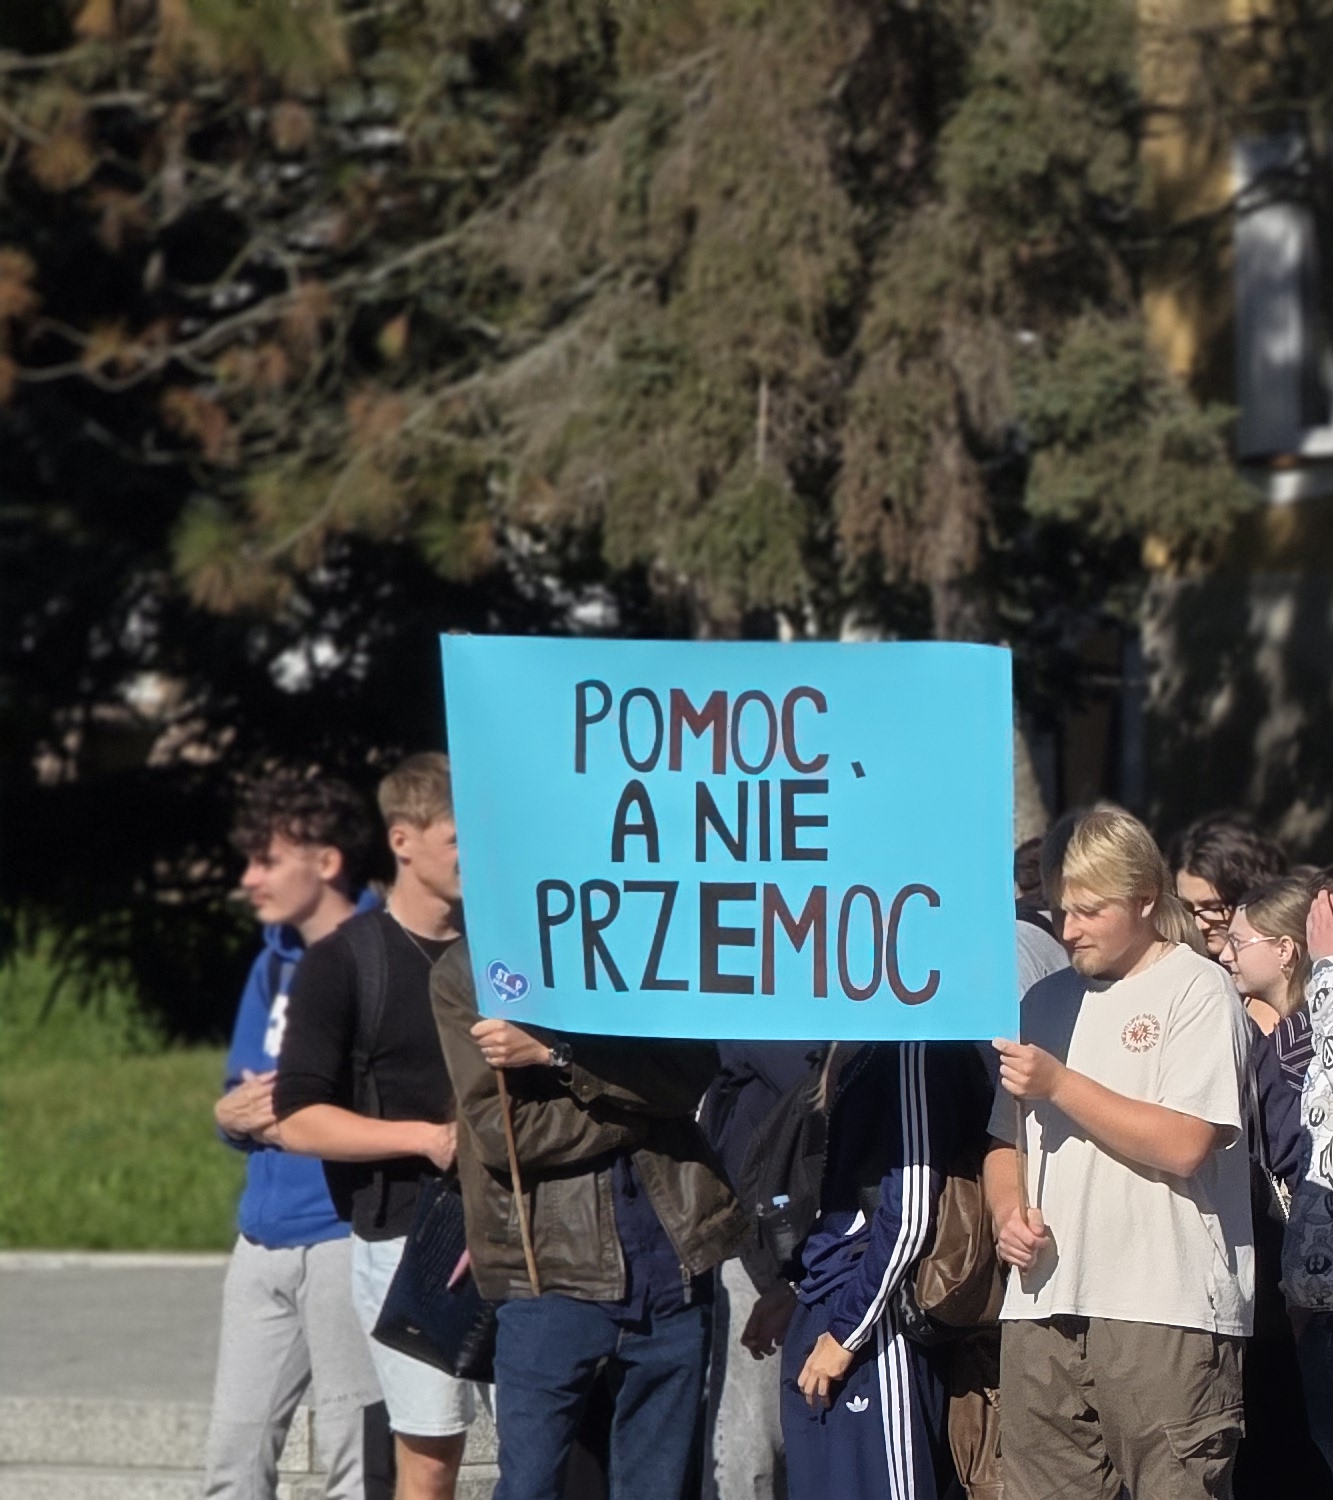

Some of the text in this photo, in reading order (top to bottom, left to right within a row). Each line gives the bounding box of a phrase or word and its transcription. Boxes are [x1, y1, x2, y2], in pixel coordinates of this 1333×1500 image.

[611, 779, 829, 863] A NIE
[536, 879, 941, 1005] PRZEMOC
